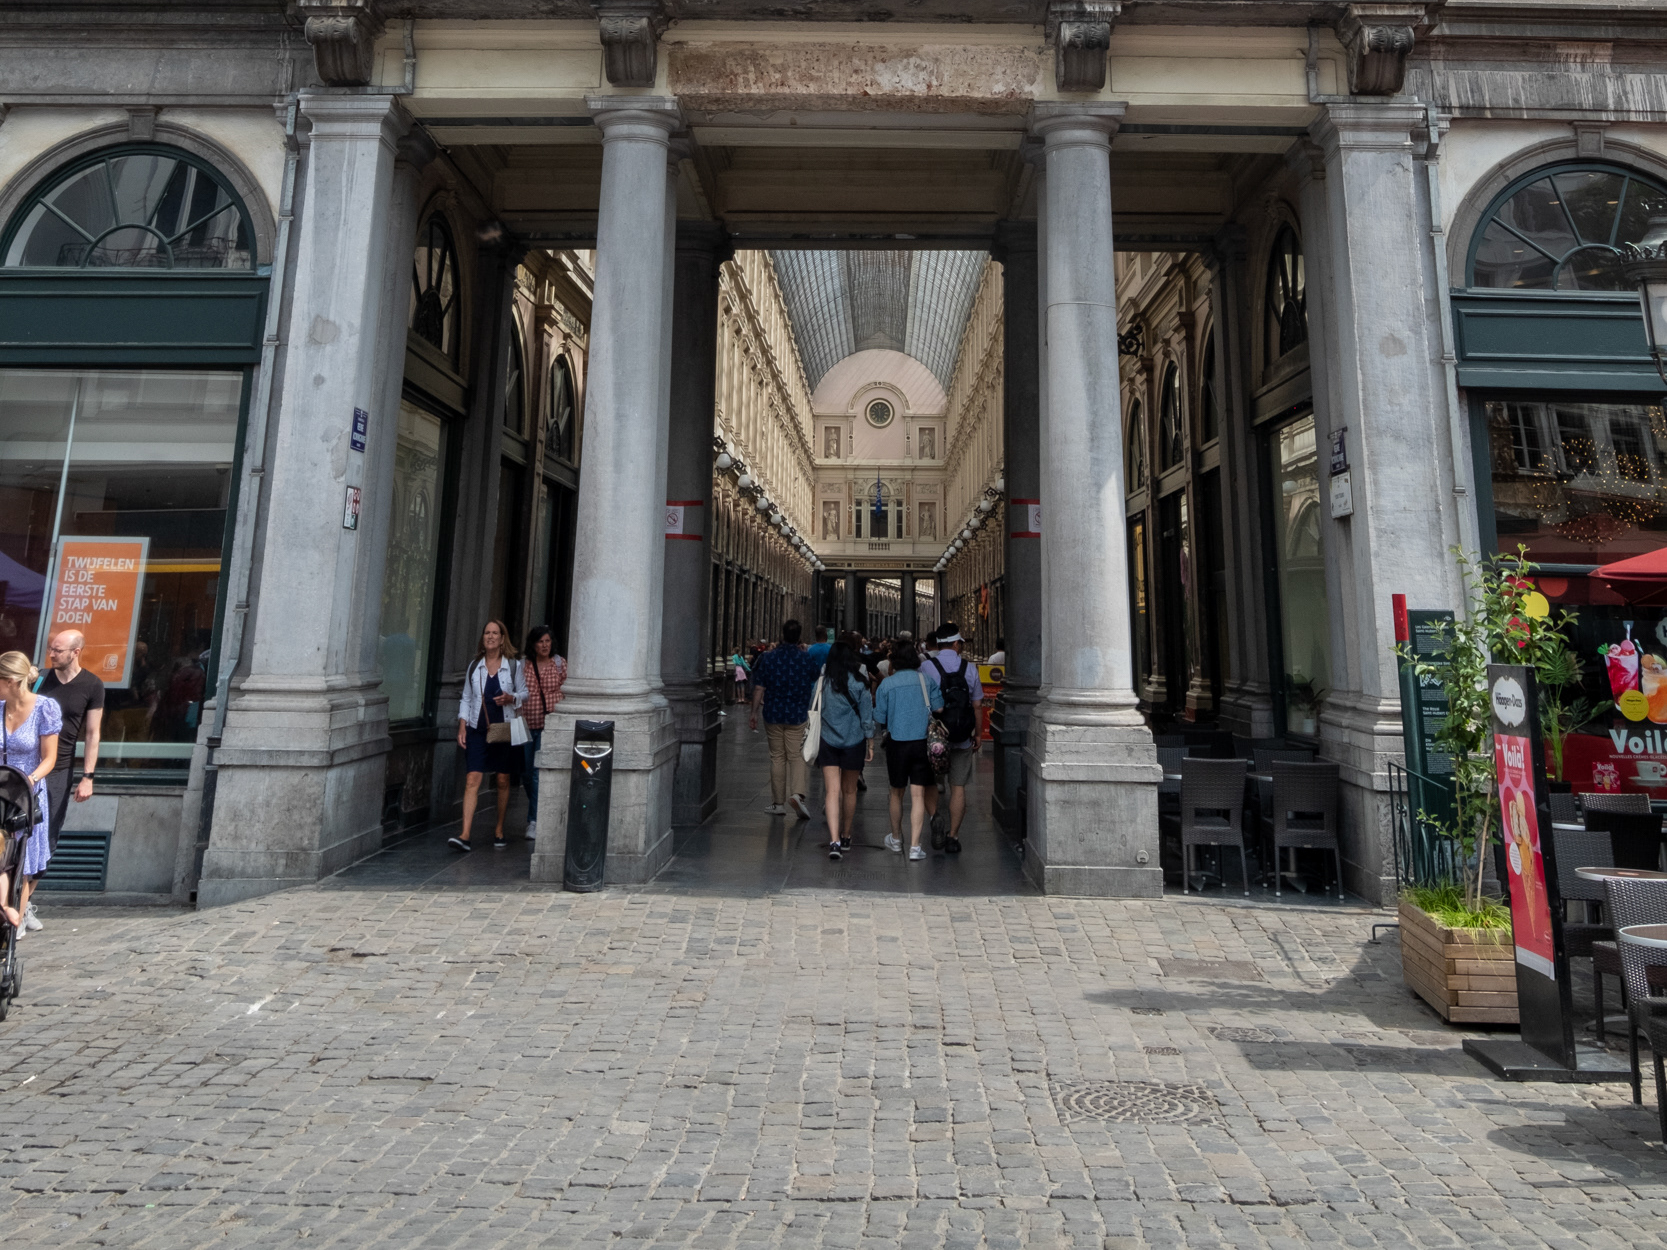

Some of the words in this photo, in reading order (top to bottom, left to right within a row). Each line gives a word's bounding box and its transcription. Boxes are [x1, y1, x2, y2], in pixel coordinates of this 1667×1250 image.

[67, 556, 135, 570] TWIJFELEN
[64, 571, 76, 581] IS
[78, 571, 95, 582] DE
[61, 584, 106, 597] EERSTE
[59, 597, 89, 610] STAP
[92, 599, 118, 611] VAN
[56, 612, 93, 624] DOEN
[1495, 692, 1523, 710] Häagen-Dazs
[1609, 729, 1667, 754] Voil
[1502, 743, 1525, 769] Voilà!
